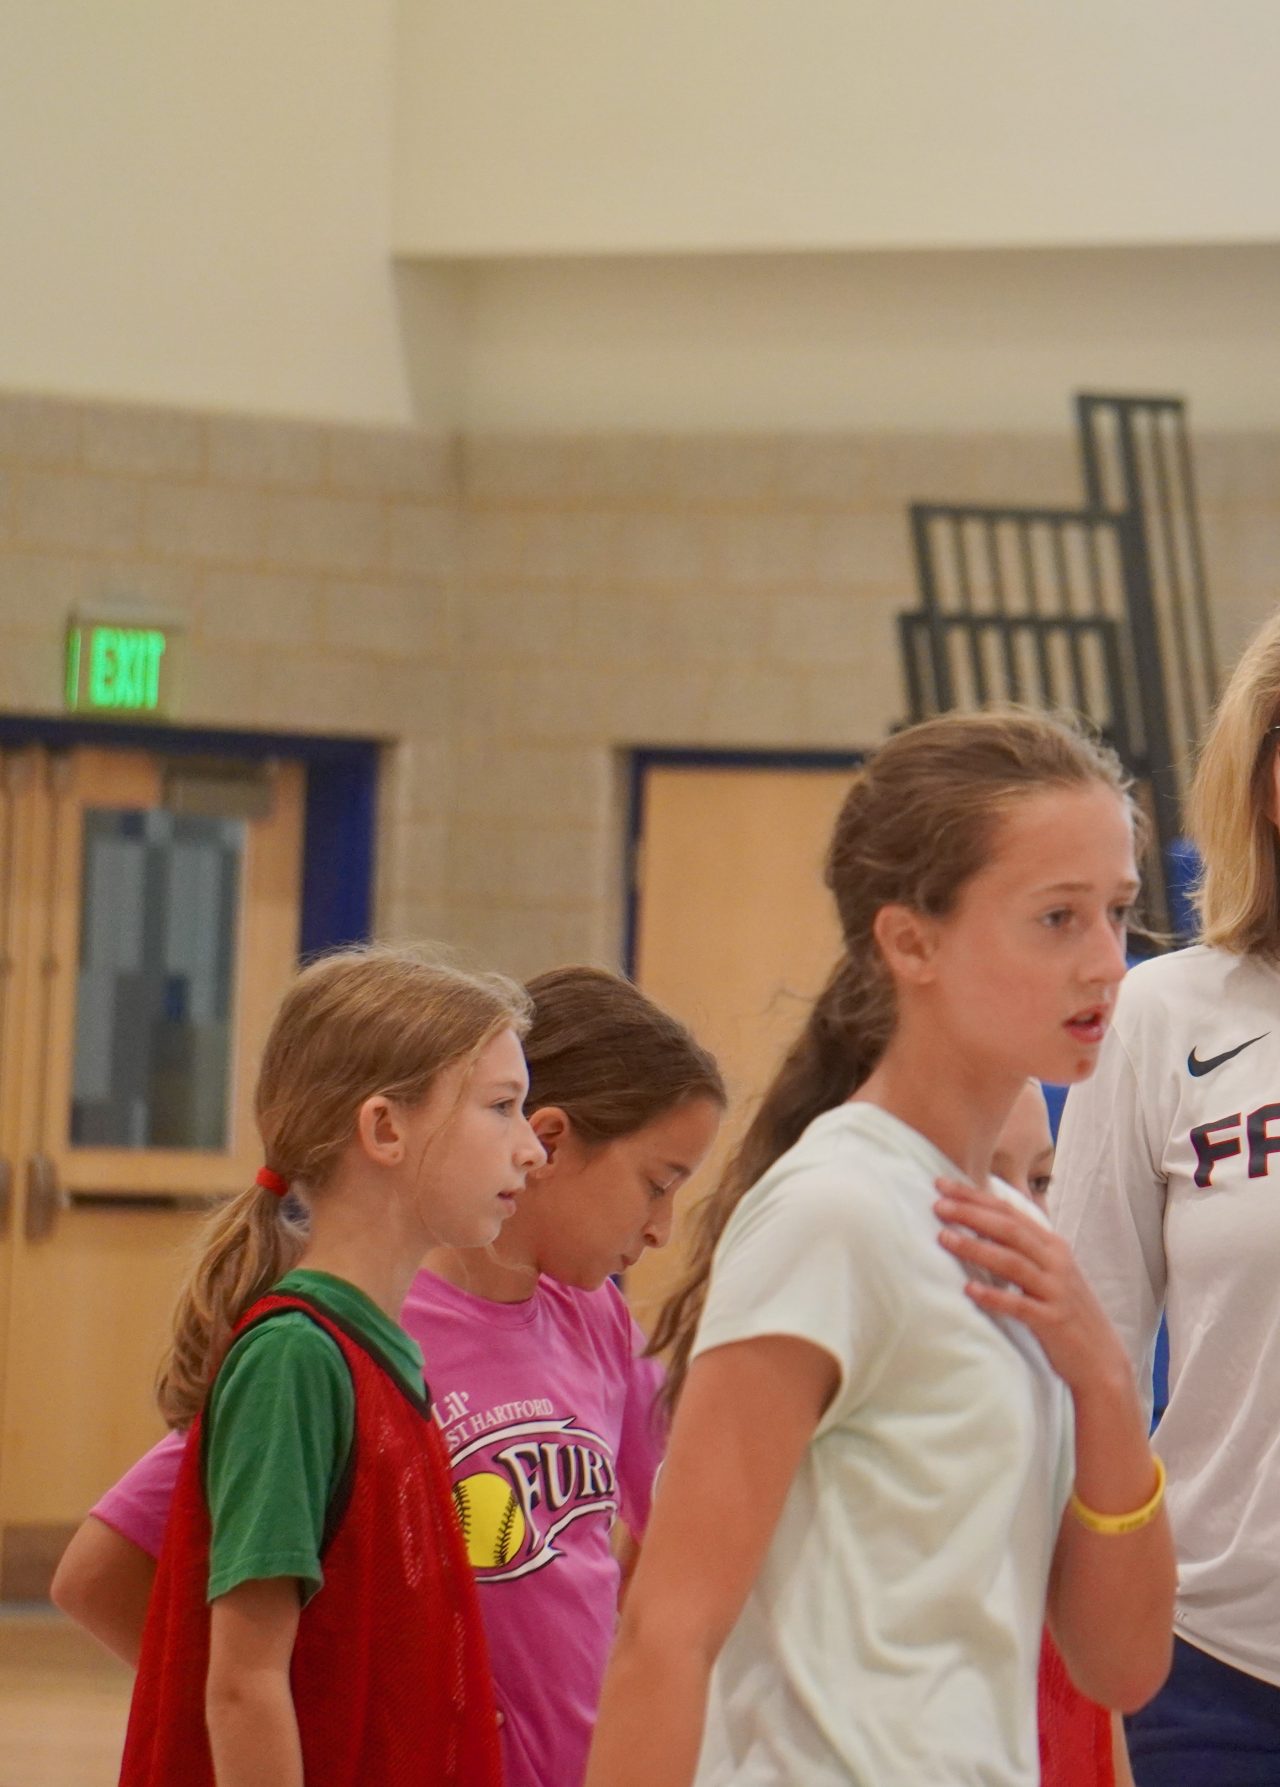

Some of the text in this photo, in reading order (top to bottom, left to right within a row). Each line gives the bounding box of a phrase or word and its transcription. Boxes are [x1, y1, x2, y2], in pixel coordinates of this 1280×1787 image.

[90, 627, 166, 709] EXIT
[444, 1398, 554, 1454] ST HARTFORD
